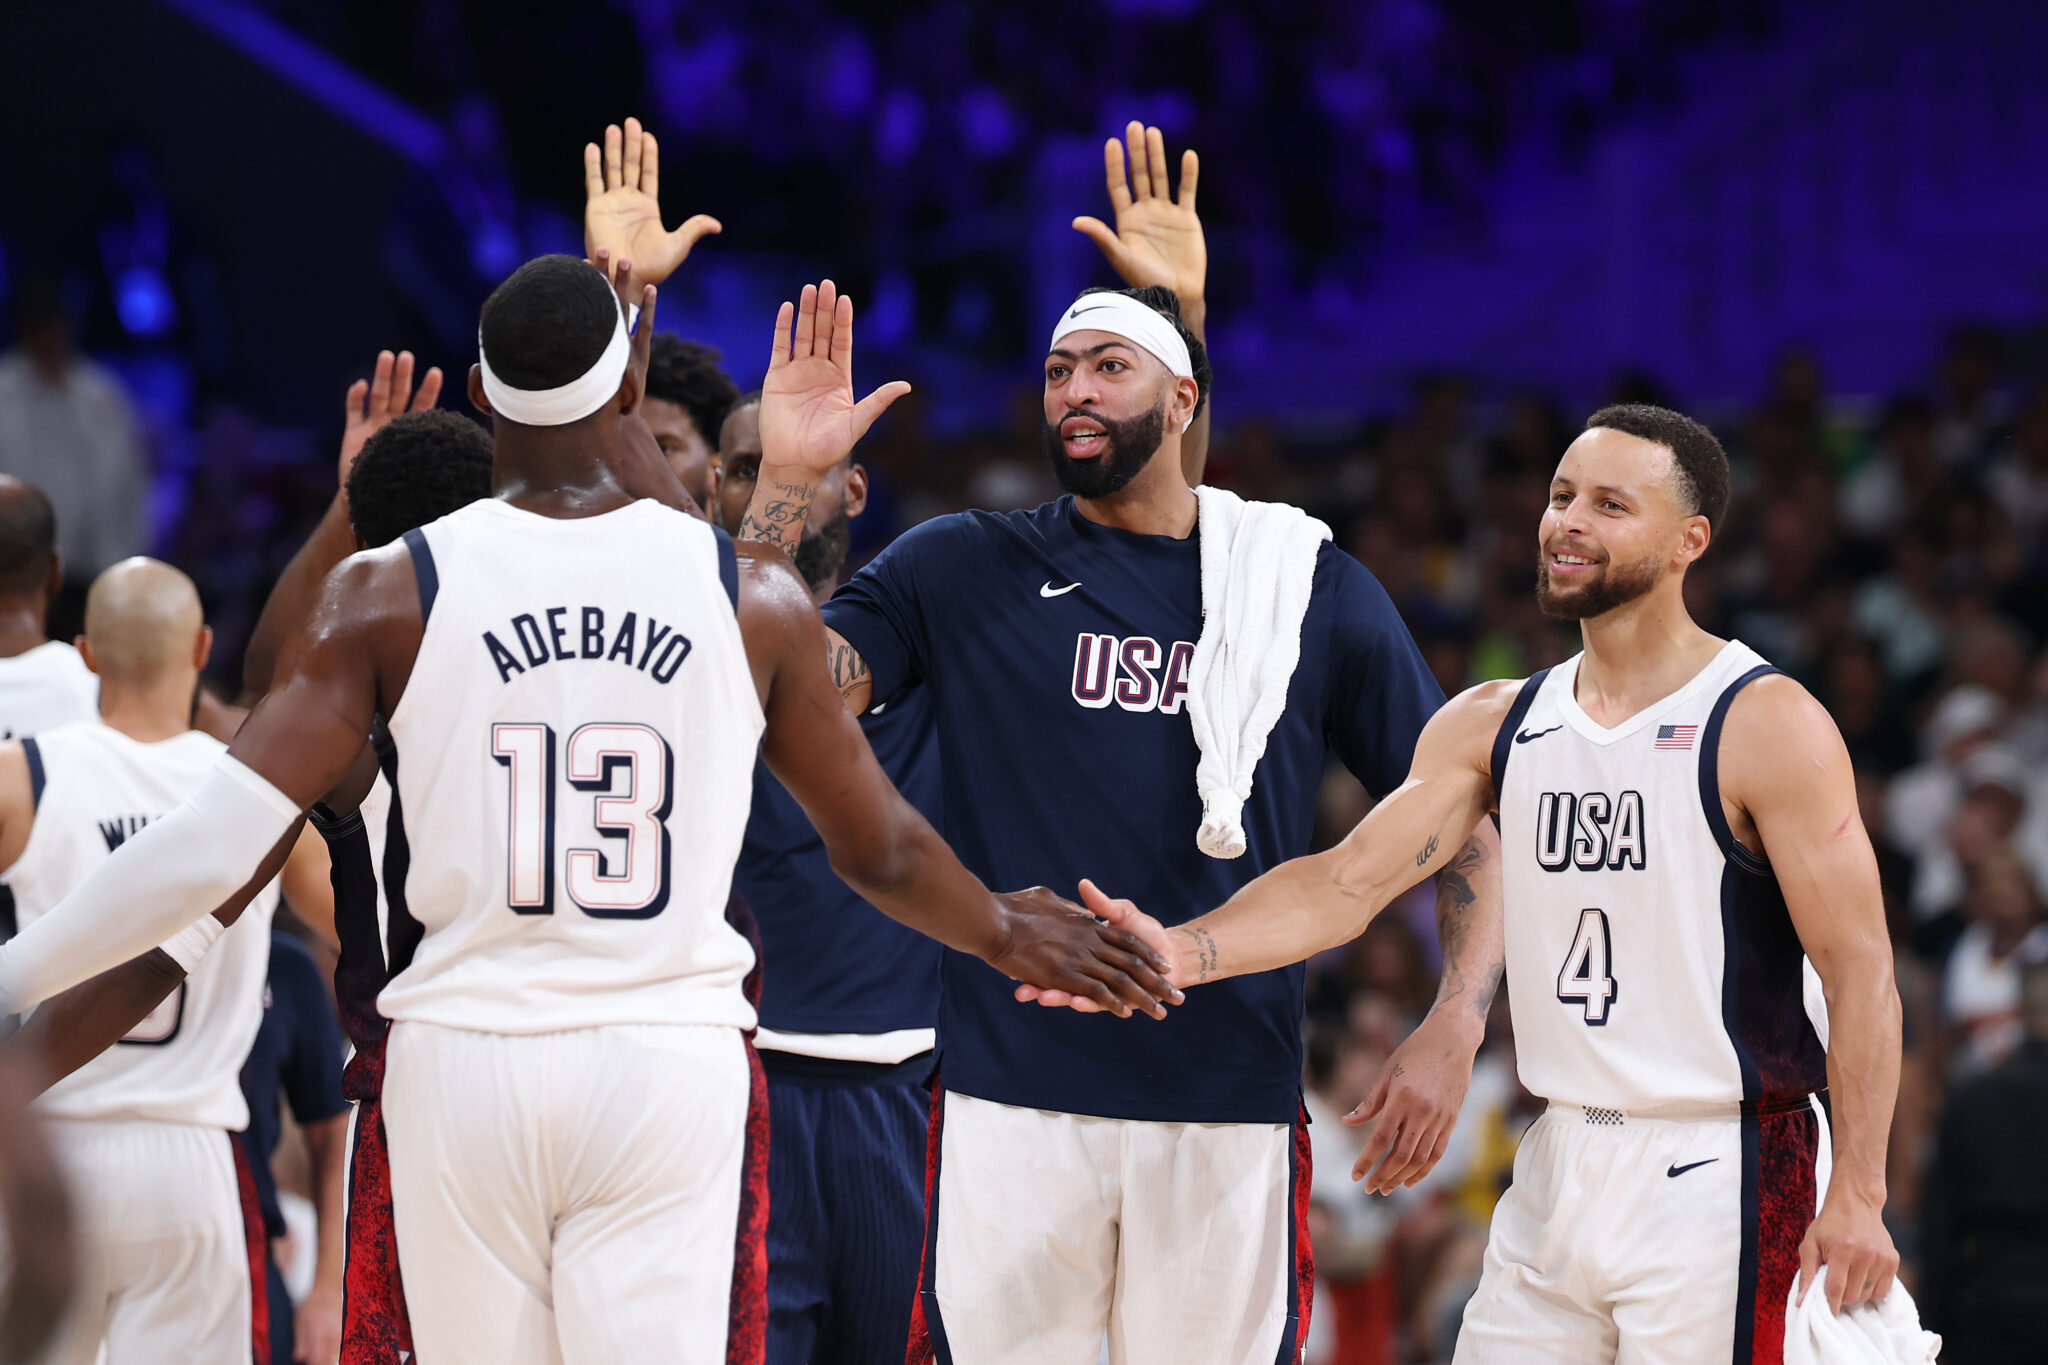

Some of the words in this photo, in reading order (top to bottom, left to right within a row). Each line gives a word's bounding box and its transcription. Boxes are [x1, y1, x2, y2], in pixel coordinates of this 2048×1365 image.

[482, 606, 692, 684] ADEBAYO
[1071, 632, 1196, 715] USA
[491, 722, 674, 920] 13
[1536, 790, 1646, 872] USA
[1557, 908, 1618, 1026] 4
